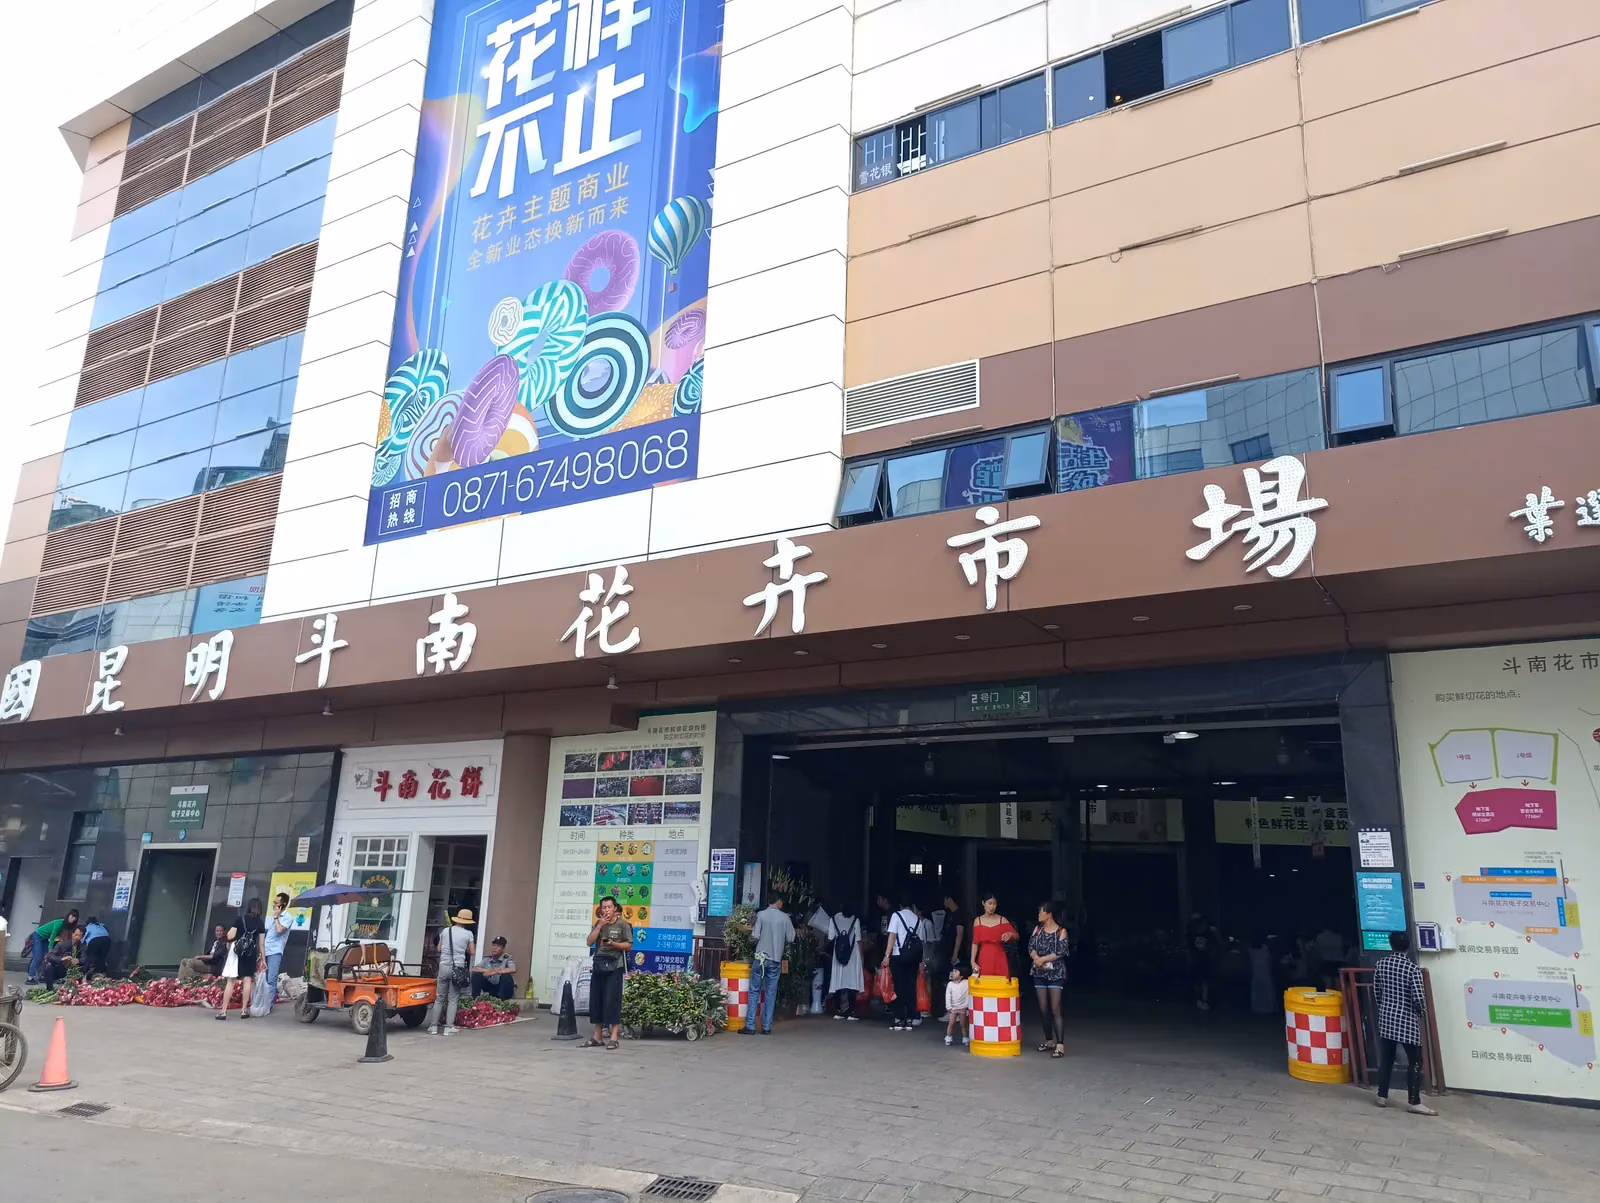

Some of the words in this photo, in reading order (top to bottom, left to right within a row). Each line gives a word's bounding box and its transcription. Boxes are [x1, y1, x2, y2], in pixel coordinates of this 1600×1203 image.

[470, 63, 646, 199] 不止
[472, 161, 630, 244] 花卉主题商业
[466, 196, 629, 272] 全新业态换新而来
[442, 429, 689, 517] 0871-67498068
[389, 488, 418, 509] 招商
[386, 509, 416, 528] 热线
[1502, 652, 1600, 675] 斗南花市
[971, 692, 999, 704] 2号门
[373, 766, 484, 801] 斗南花饼
[570, 831, 586, 841] 时间
[619, 829, 634, 840] 种类
[668, 829, 685, 839] 地点
[1458, 944, 1519, 955] 夜间交易导视图
[1470, 1050, 1532, 1063] 日间交易导视图
